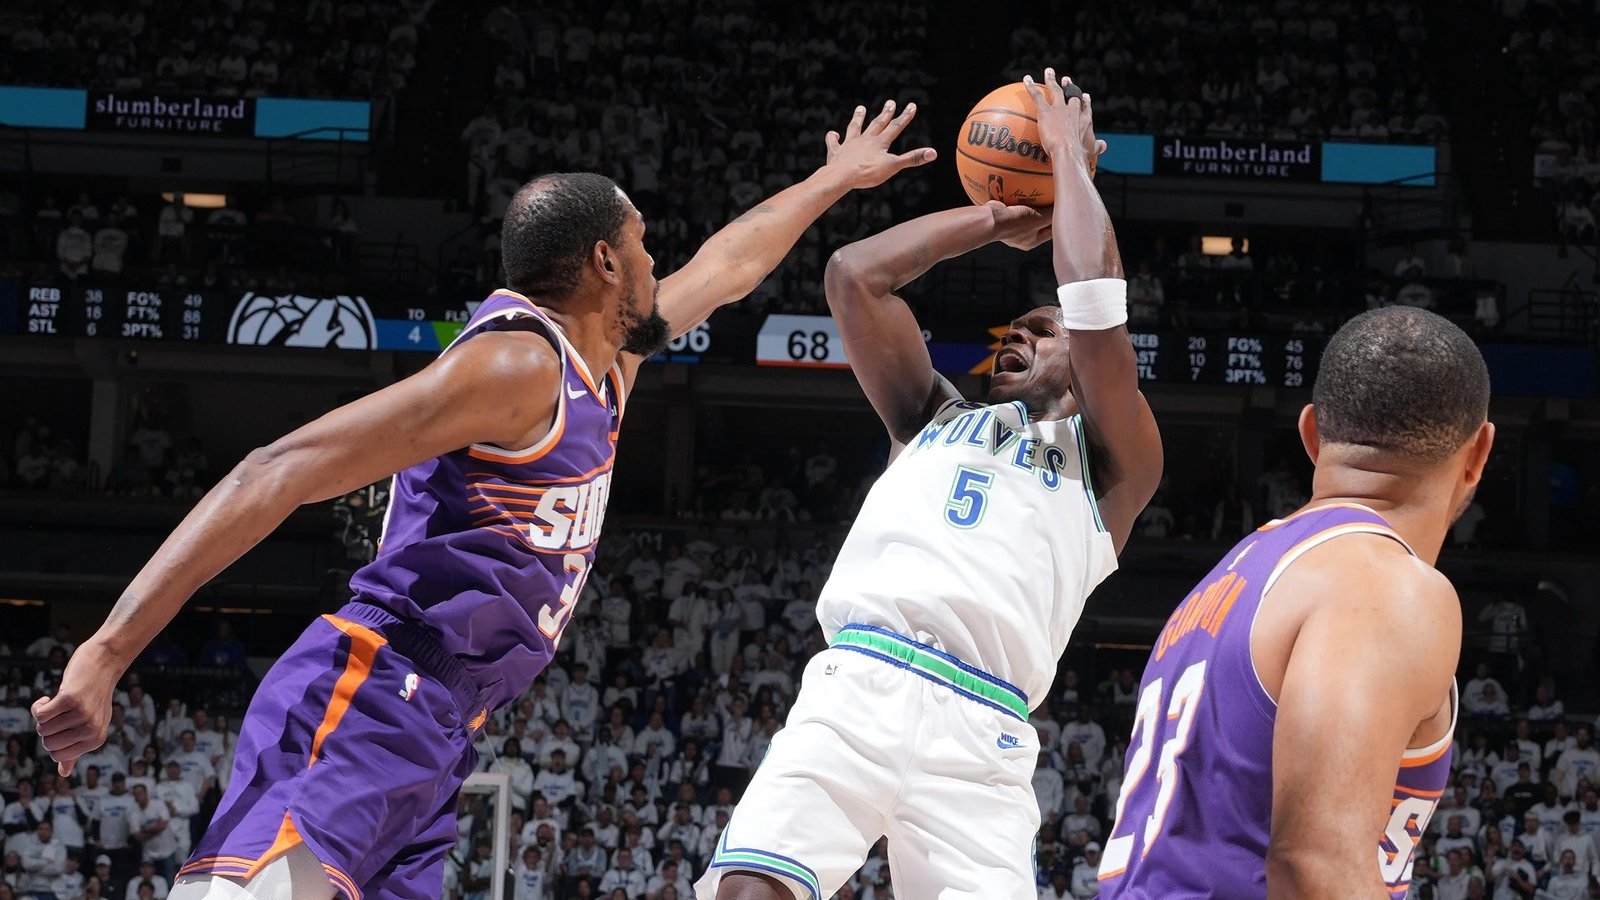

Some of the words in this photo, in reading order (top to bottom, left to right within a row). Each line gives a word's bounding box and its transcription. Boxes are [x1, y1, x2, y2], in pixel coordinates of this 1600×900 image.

[96, 94, 245, 118] slumberland
[117, 117, 223, 131] FURNITURE
[967, 120, 1050, 165] Wilson
[1162, 139, 1312, 164] slumberland
[1184, 162, 1290, 176] FURNITURE
[29, 287, 61, 302] REB
[85, 289, 103, 304] 38
[127, 291, 162, 307] FG%
[184, 294, 202, 308] 49
[28, 303, 60, 318] AST
[127, 306, 160, 322] FT%
[408, 308, 425, 320] TO
[445, 309, 469, 322] FLS
[28, 318, 57, 334] STL
[86, 321, 97, 337] 6
[121, 322, 163, 339] 3PT%
[182, 325, 200, 340] 31
[407, 325, 422, 345] 4
[787, 329, 830, 362] 68
[1130, 333, 1159, 348] REB
[1188, 336, 1206, 351] 20
[1227, 336, 1263, 353] FG%
[1285, 339, 1303, 354] 45
[1137, 350, 1158, 365] ST
[1188, 352, 1206, 368] 10
[1228, 352, 1261, 369] FT%
[1285, 354, 1304, 371] 76
[1138, 365, 1157, 380] TL
[1191, 367, 1200, 381] 7
[1225, 368, 1267, 385] 3PT%
[1284, 371, 1303, 387] 29
[911, 408, 1067, 492] WOLVES
[942, 463, 996, 531] 5
[1001, 732, 1020, 746] NIKE
[1097, 660, 1207, 881] 23
